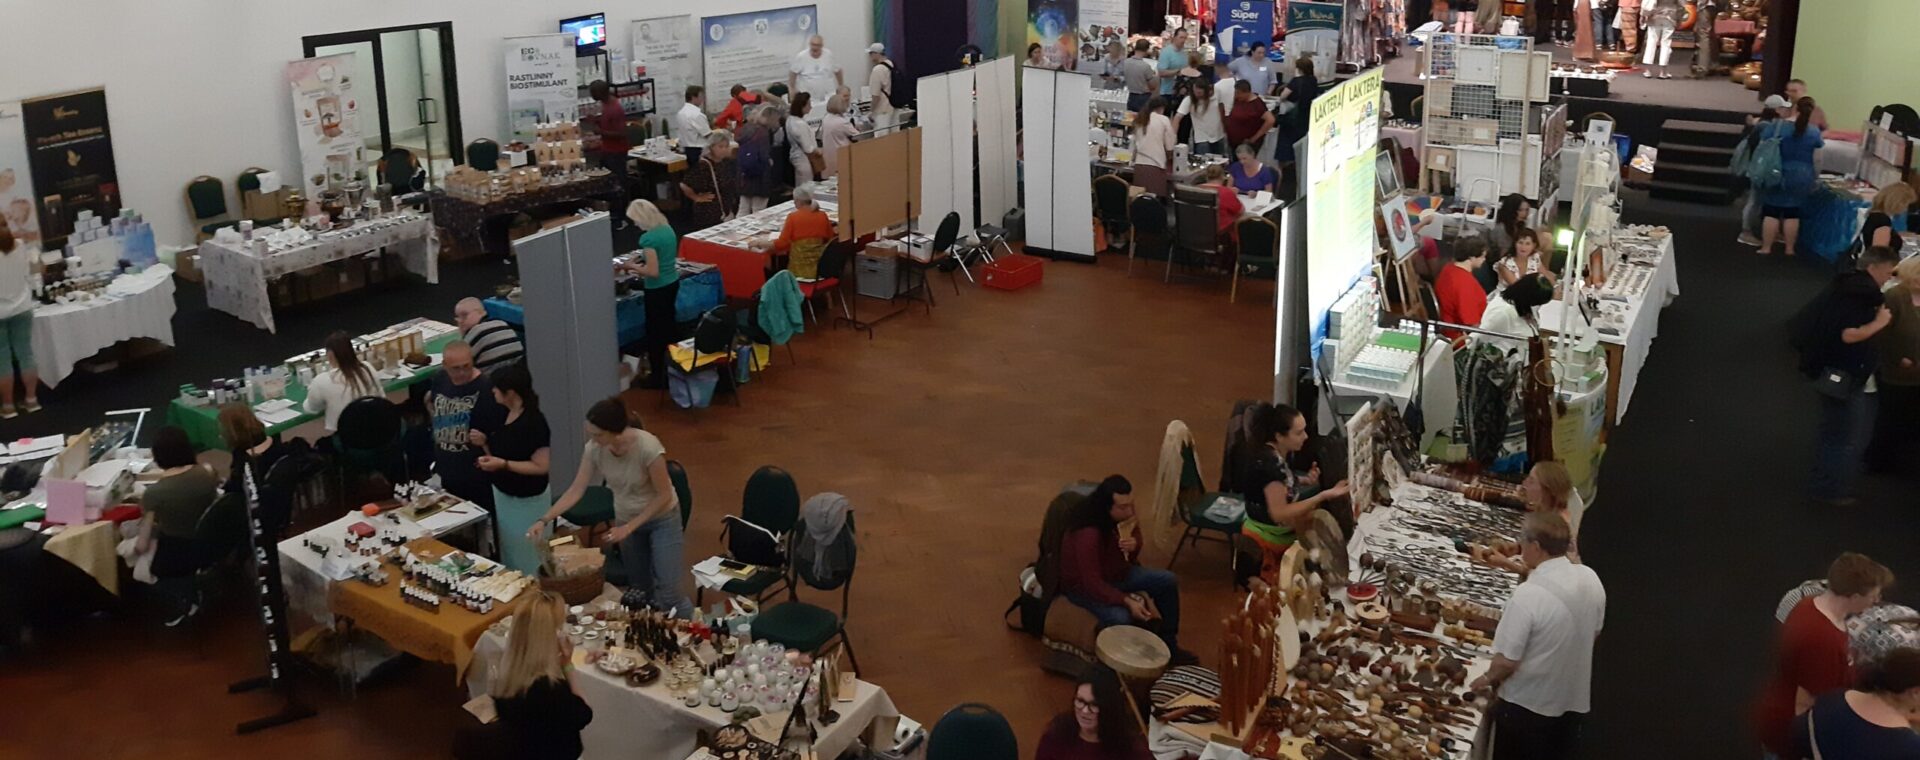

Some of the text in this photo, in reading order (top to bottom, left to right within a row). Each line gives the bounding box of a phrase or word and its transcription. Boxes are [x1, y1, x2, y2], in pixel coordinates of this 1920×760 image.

[510, 79, 568, 90] BIOSTIMULANT
[1349, 73, 1380, 102] LAKTERA
[1314, 93, 1343, 122] LAKTERA
